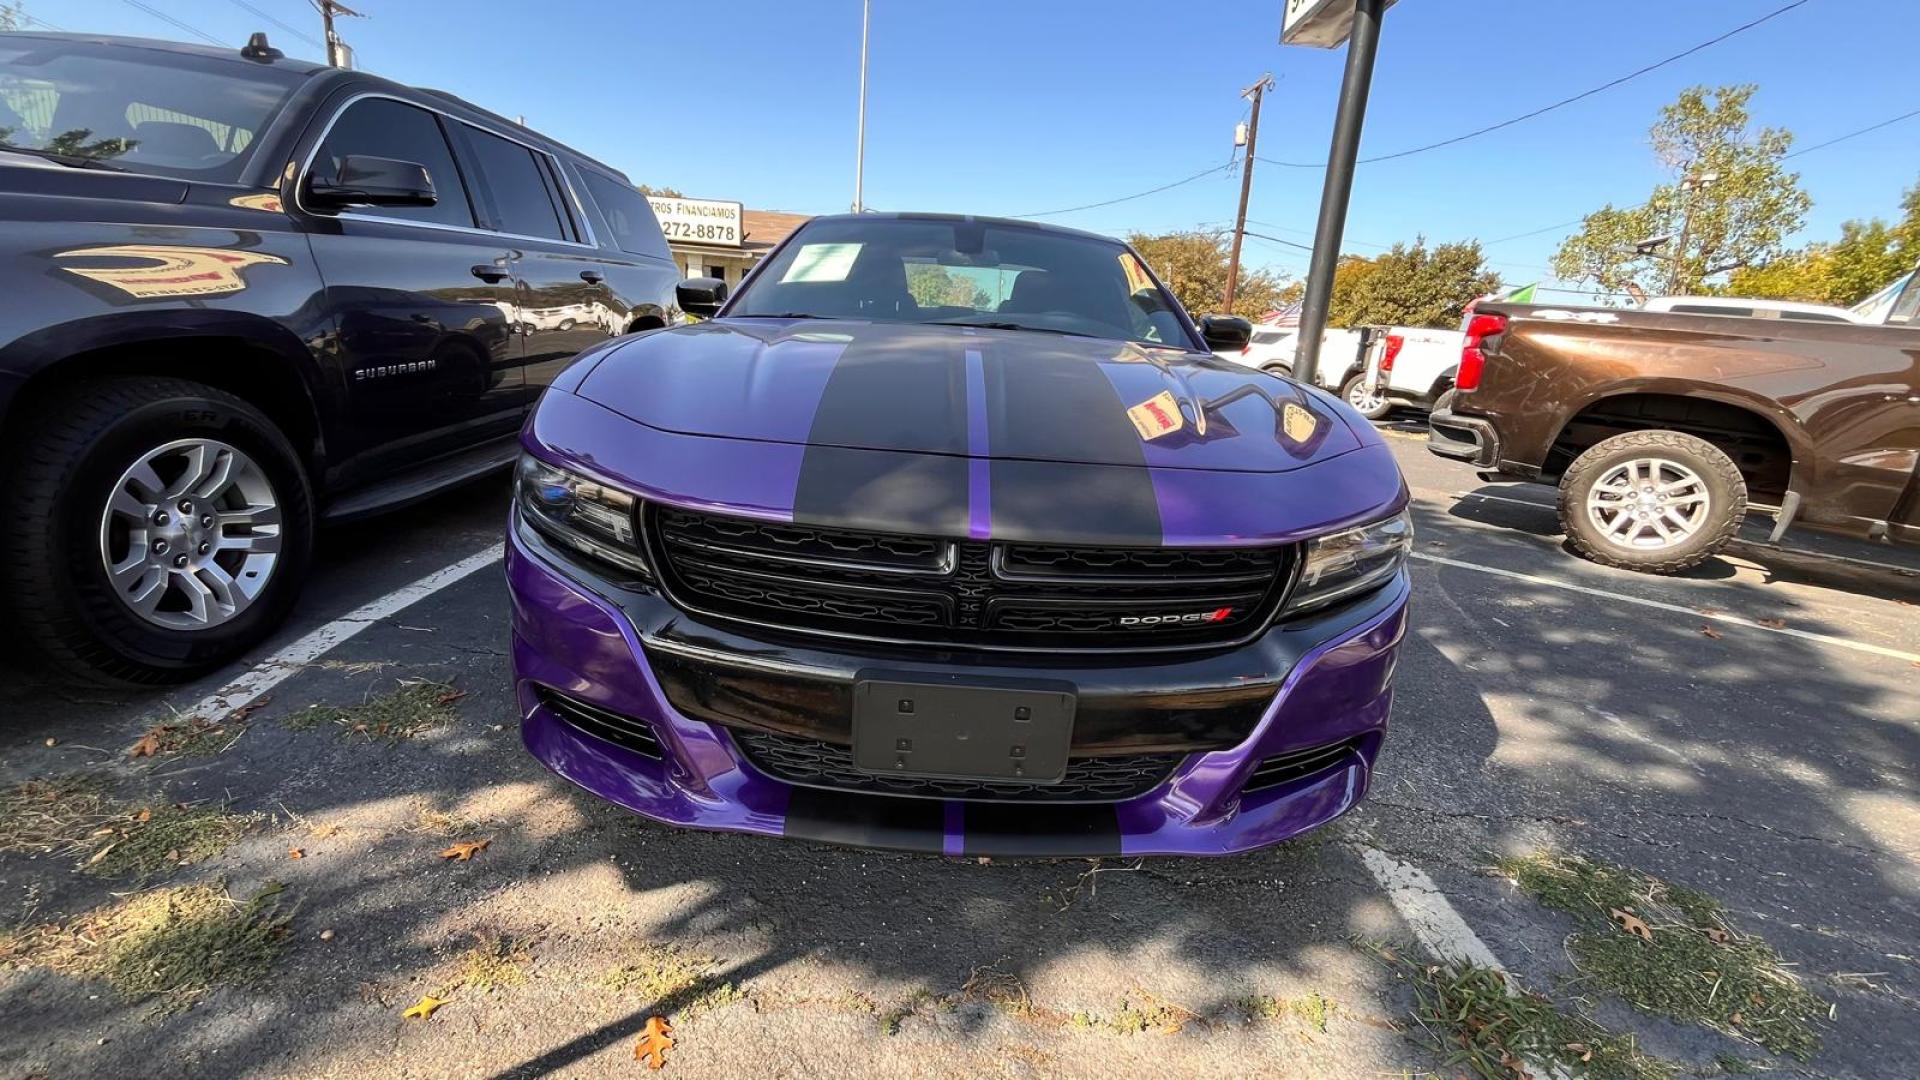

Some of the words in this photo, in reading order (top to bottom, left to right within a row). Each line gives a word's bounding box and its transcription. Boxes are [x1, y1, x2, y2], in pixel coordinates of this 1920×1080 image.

[677, 203, 735, 219] FINANCIAMOS
[662, 221, 734, 240] 272-8878
[355, 360, 435, 380] SUBURBAN
[1120, 612, 1216, 624] DODGE
